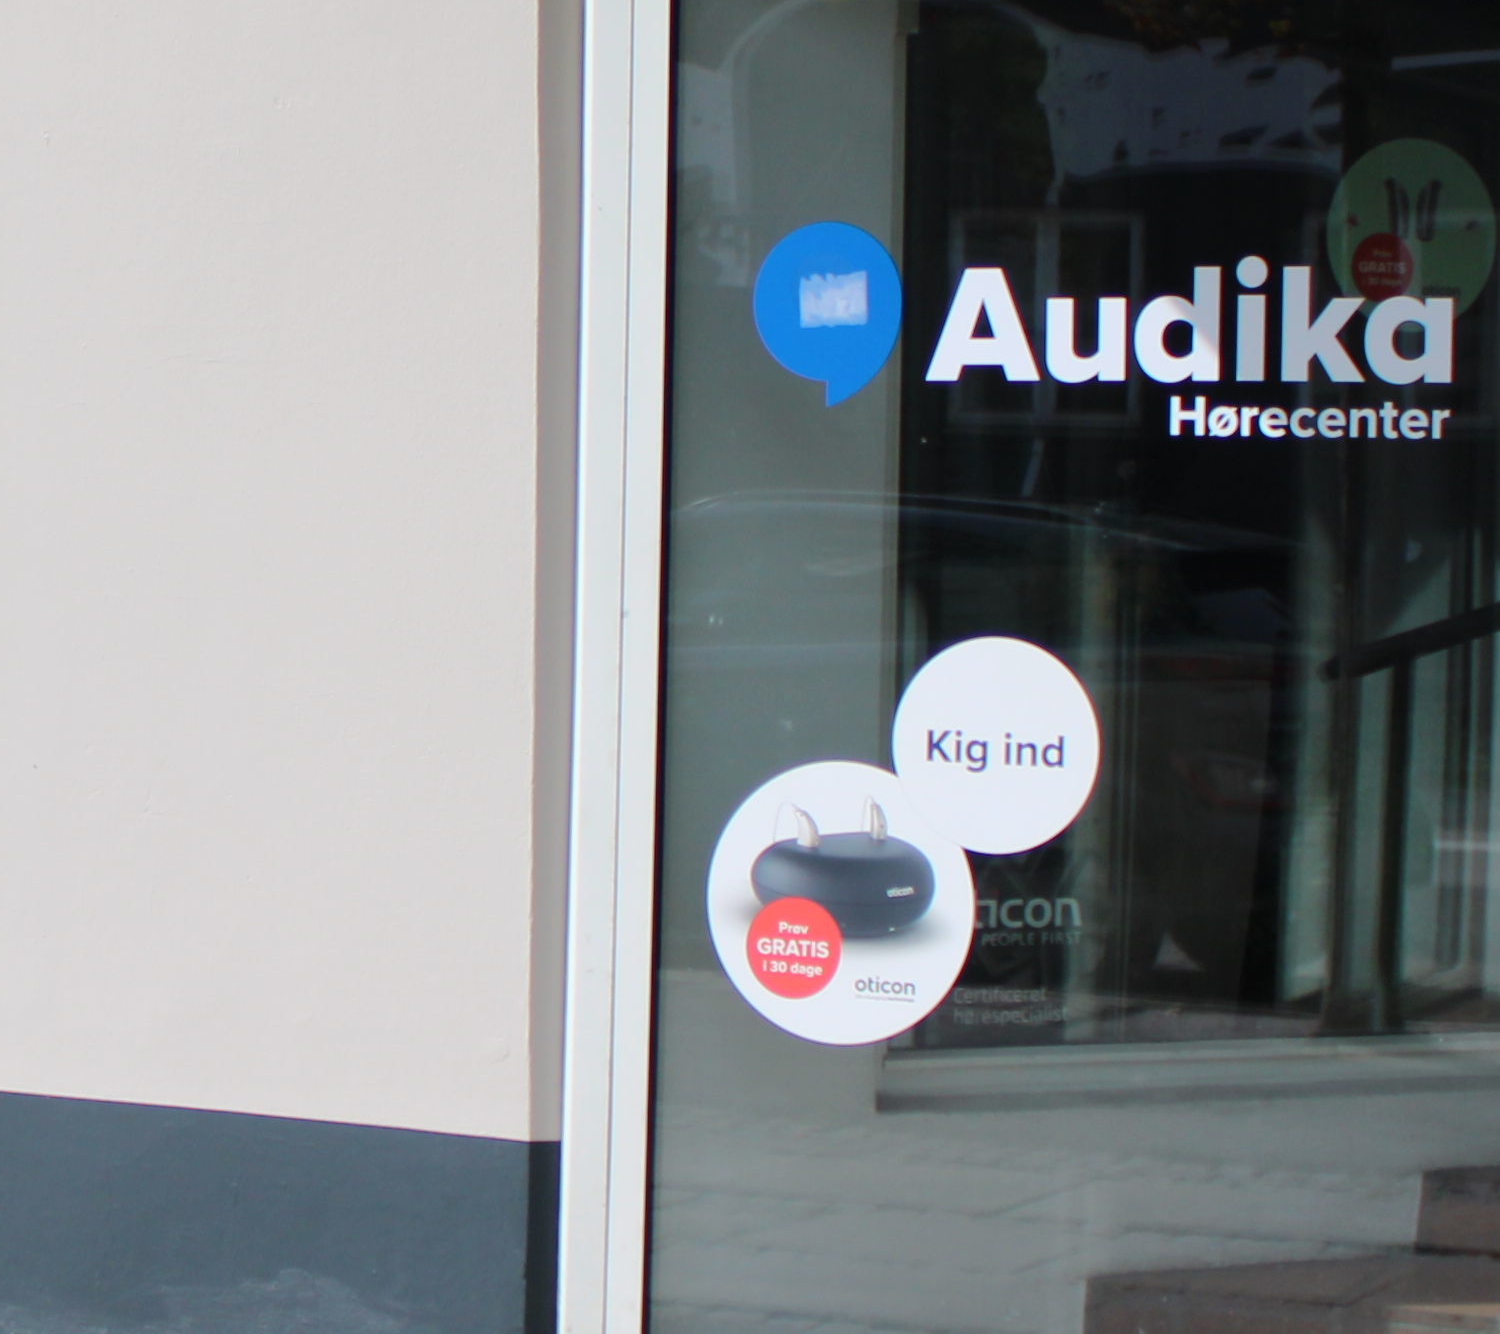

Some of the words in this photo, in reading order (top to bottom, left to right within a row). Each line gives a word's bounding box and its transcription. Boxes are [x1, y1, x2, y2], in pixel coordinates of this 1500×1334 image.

[1358, 261, 1407, 274] GRATIS
[925, 255, 1454, 384] Audika
[1169, 396, 1452, 439] Hørecenter
[926, 729, 989, 773] Kig
[1004, 732, 1066, 768] ind
[886, 886, 914, 898] oticon
[778, 921, 809, 935] Prøv
[981, 932, 1036, 947] PEOPLE
[1040, 931, 1083, 946] FIRST
[756, 938, 830, 959] GRATIS
[769, 961, 787, 974] 30
[790, 961, 823, 977] dage
[854, 977, 916, 997] oticon
[953, 987, 1047, 1004] Certificeret
